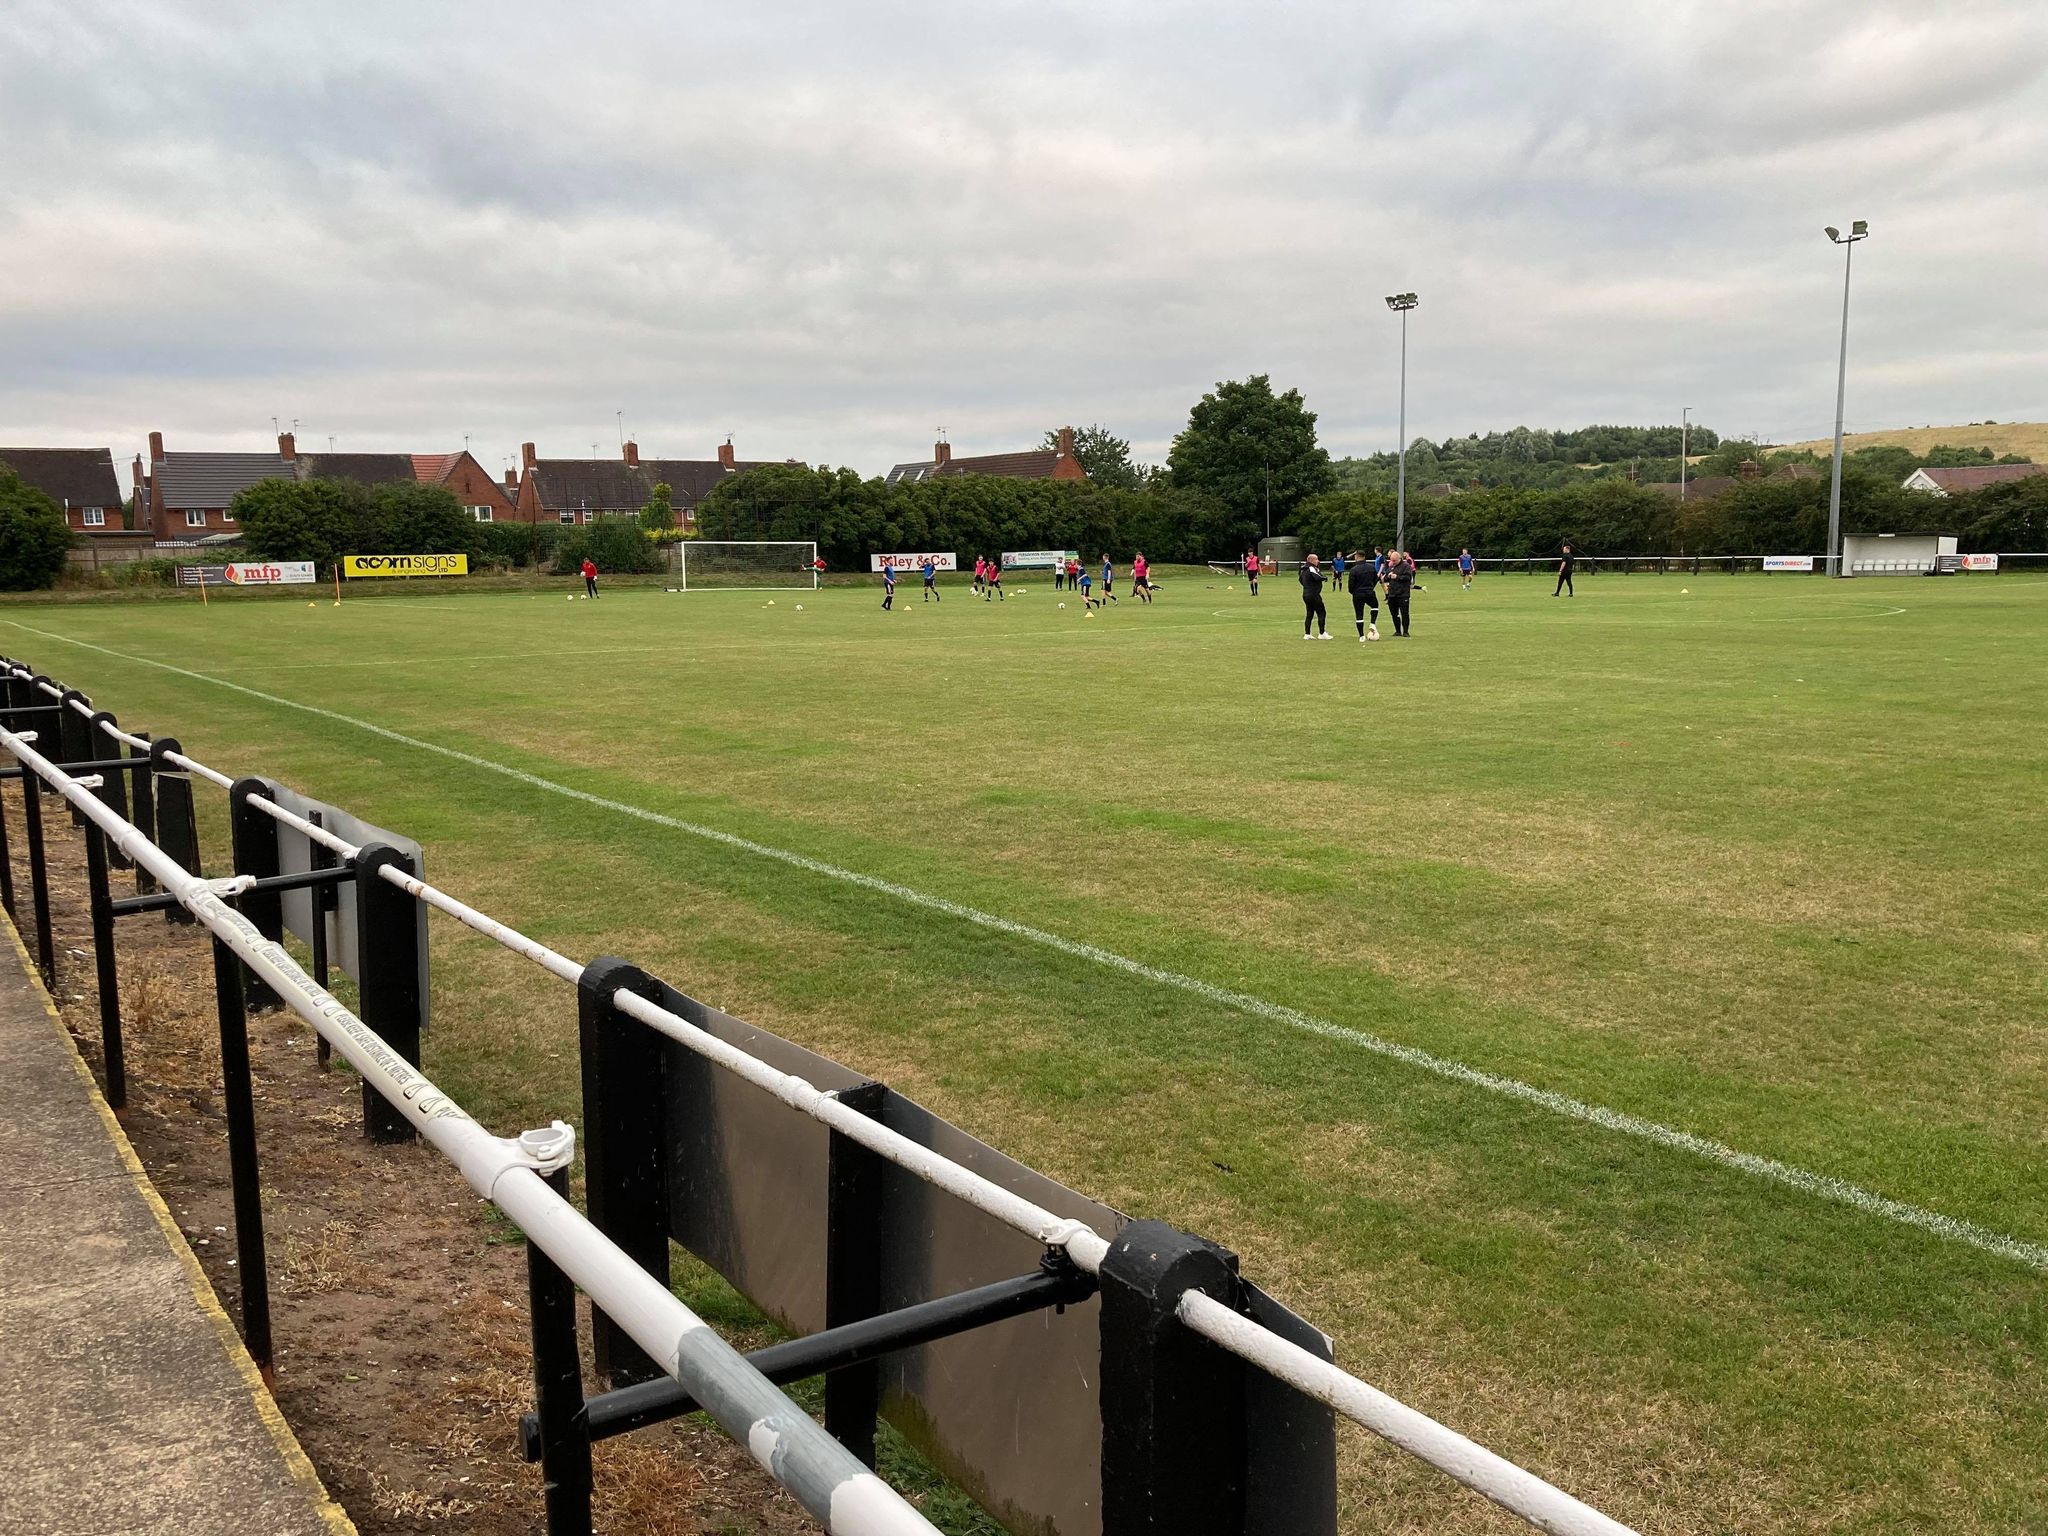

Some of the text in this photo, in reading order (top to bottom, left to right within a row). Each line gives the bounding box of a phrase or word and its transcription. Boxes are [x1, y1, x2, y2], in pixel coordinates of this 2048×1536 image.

[355, 555, 457, 572] acorn signs
[878, 555, 912, 569] Rley
[916, 554, 926, 568] &
[244, 564, 282, 581] mfp
